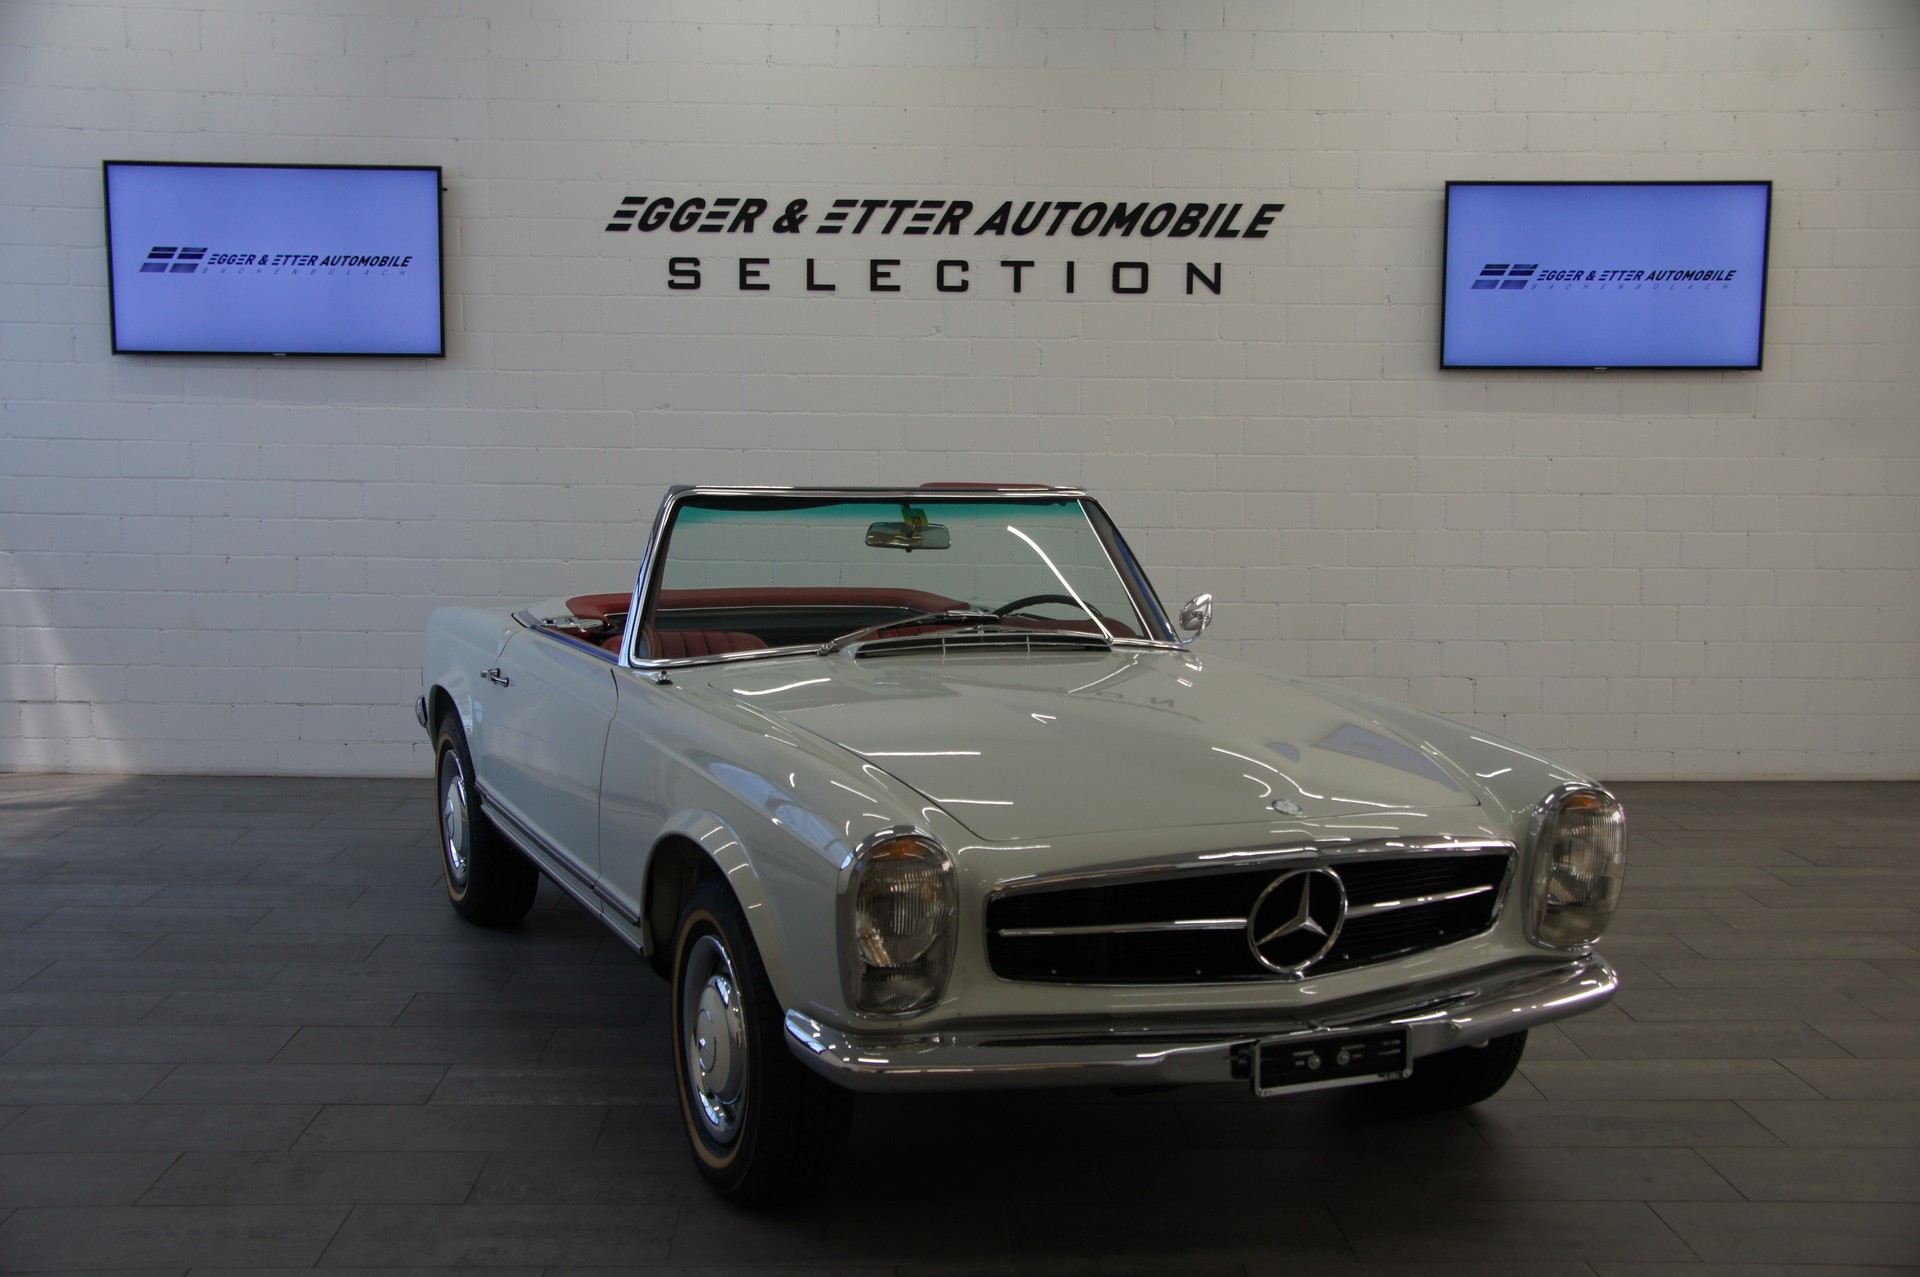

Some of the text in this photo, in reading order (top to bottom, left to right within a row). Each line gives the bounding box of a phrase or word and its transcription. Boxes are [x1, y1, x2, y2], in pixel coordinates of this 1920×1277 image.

[605, 196, 1286, 239] EGGER & ETTER AUTOMOBILE
[207, 253, 413, 267] EGGER & ETTER AUTOMOBILE
[667, 256, 1222, 295] SELECTION
[1536, 270, 1737, 281] EGGER & ETTER AUTOMOBILE
